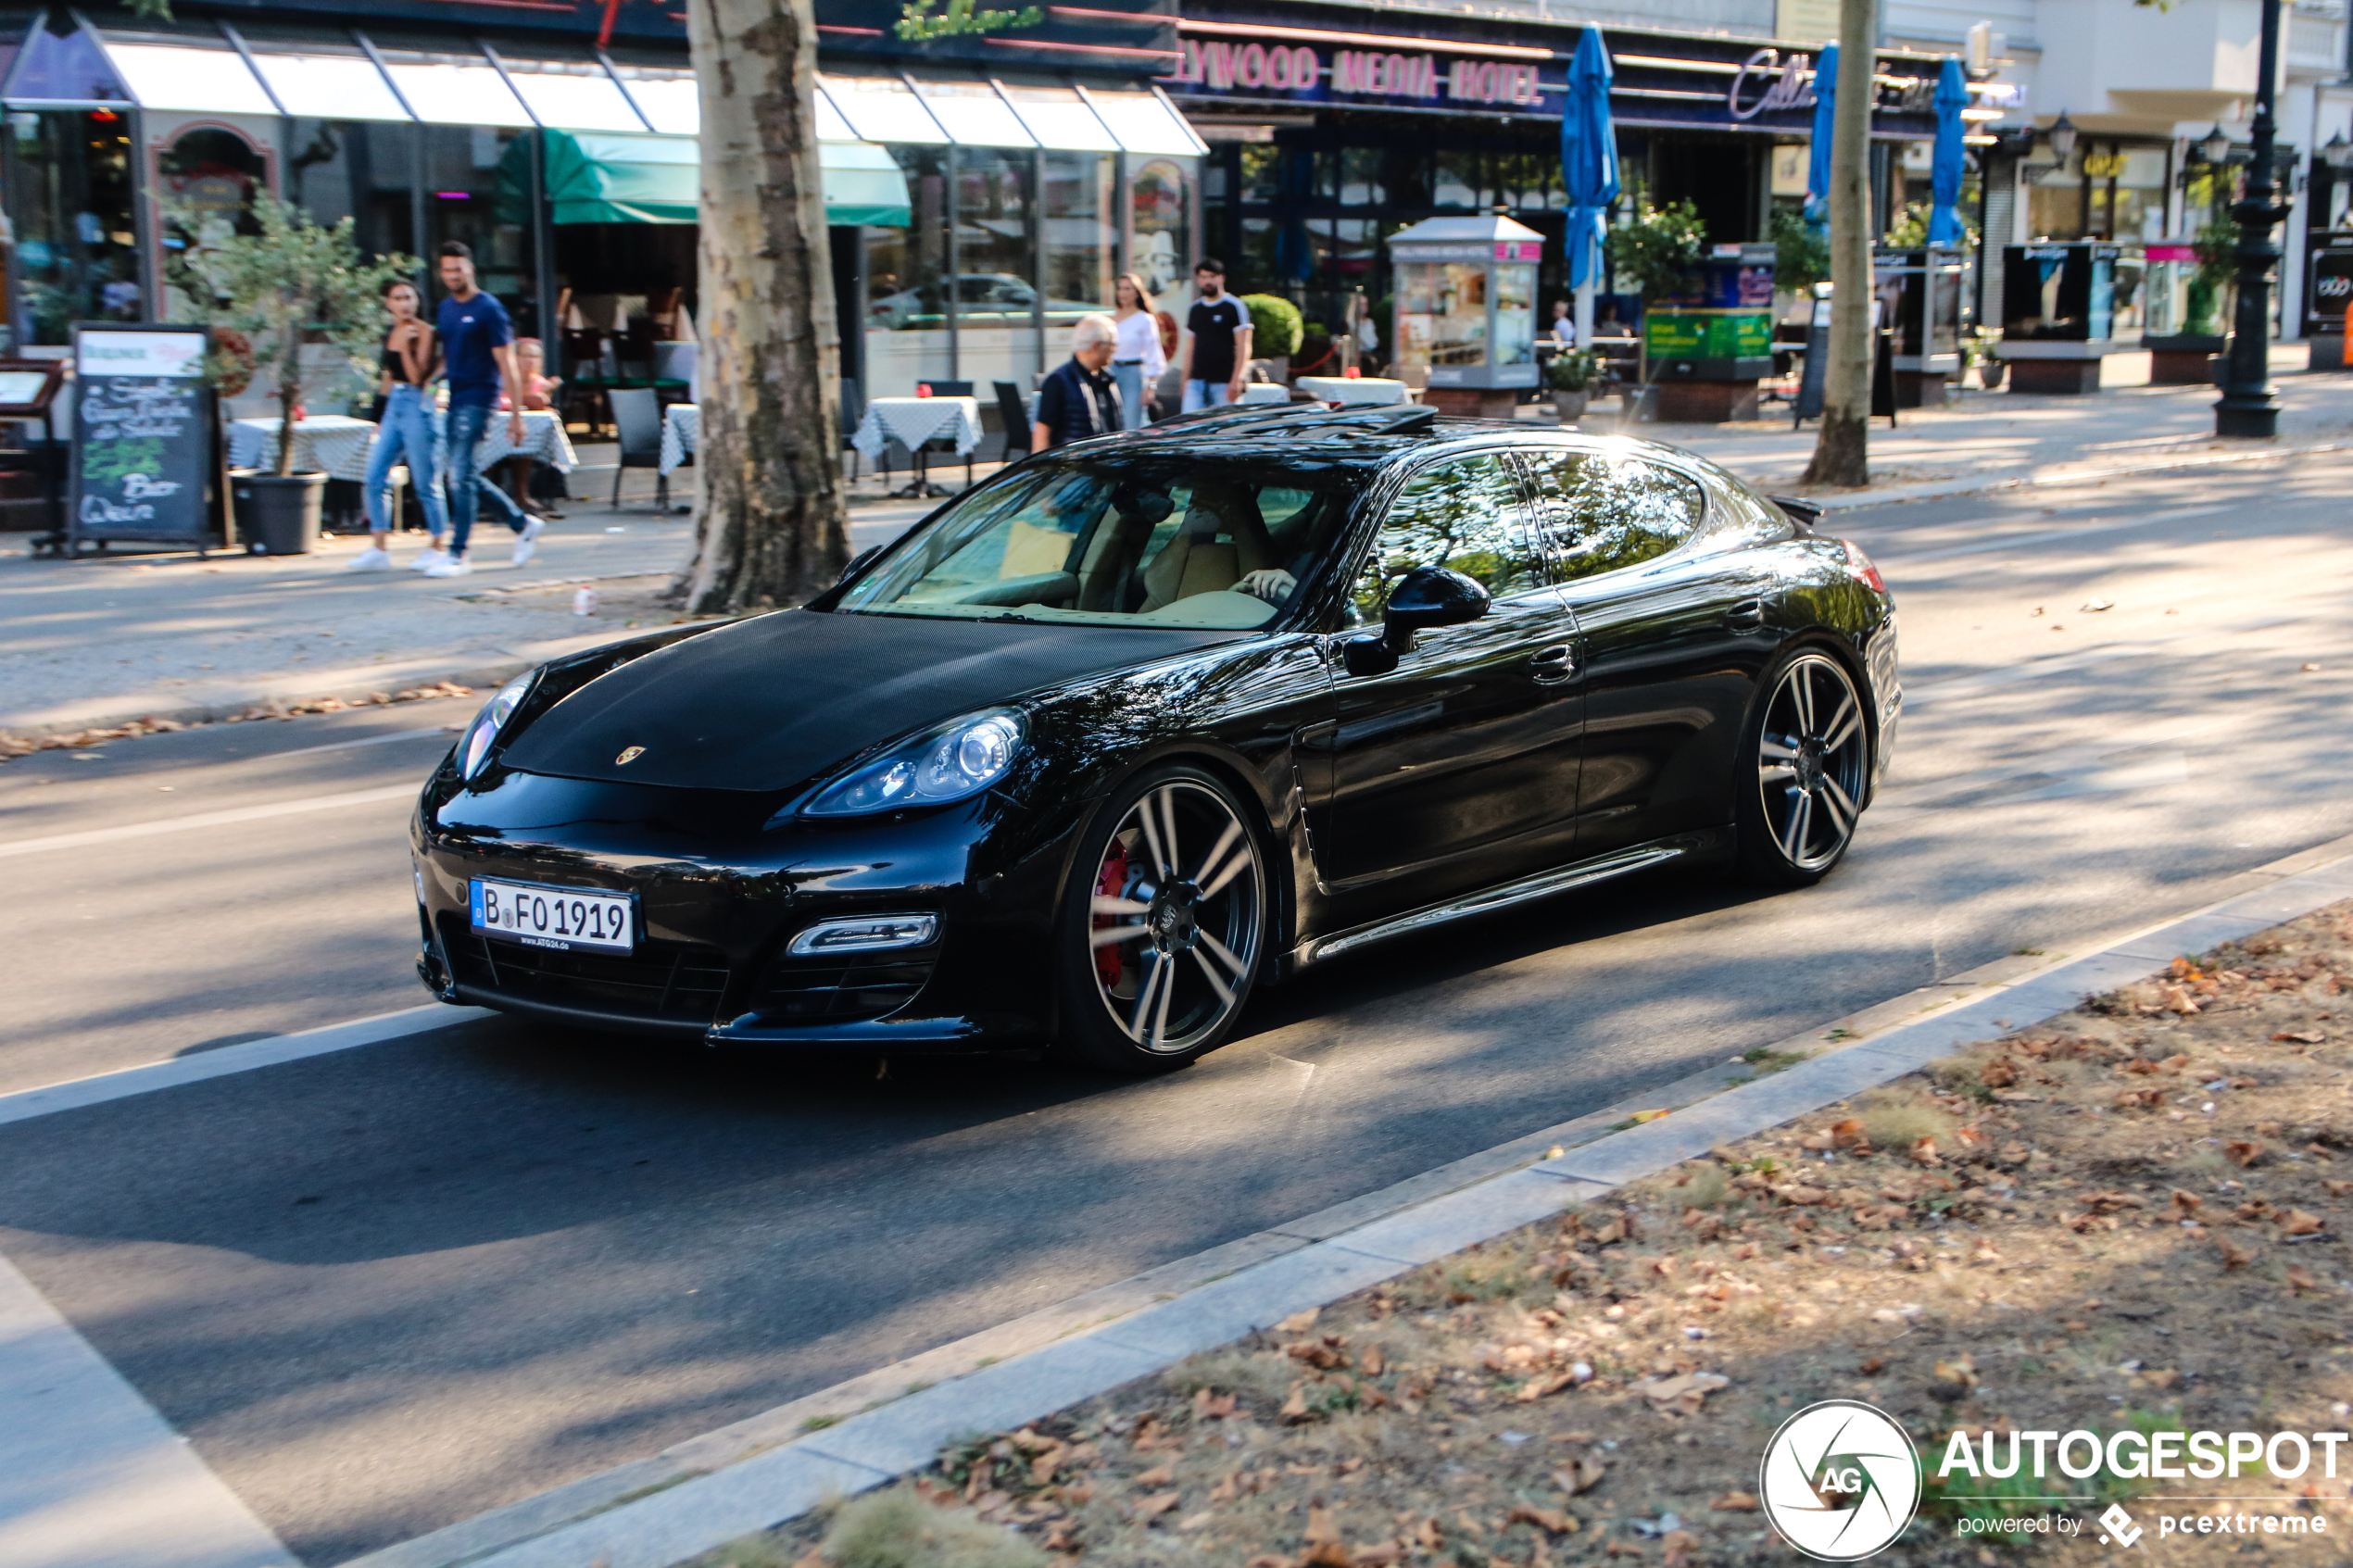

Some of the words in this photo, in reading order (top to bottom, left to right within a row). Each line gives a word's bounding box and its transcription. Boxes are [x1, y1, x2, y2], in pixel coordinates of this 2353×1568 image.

[1332, 50, 1438, 98] MEDIA
[1449, 60, 1545, 106] HOTEL
[484, 888, 500, 924] B
[521, 935, 570, 950] www.ATG24.de
